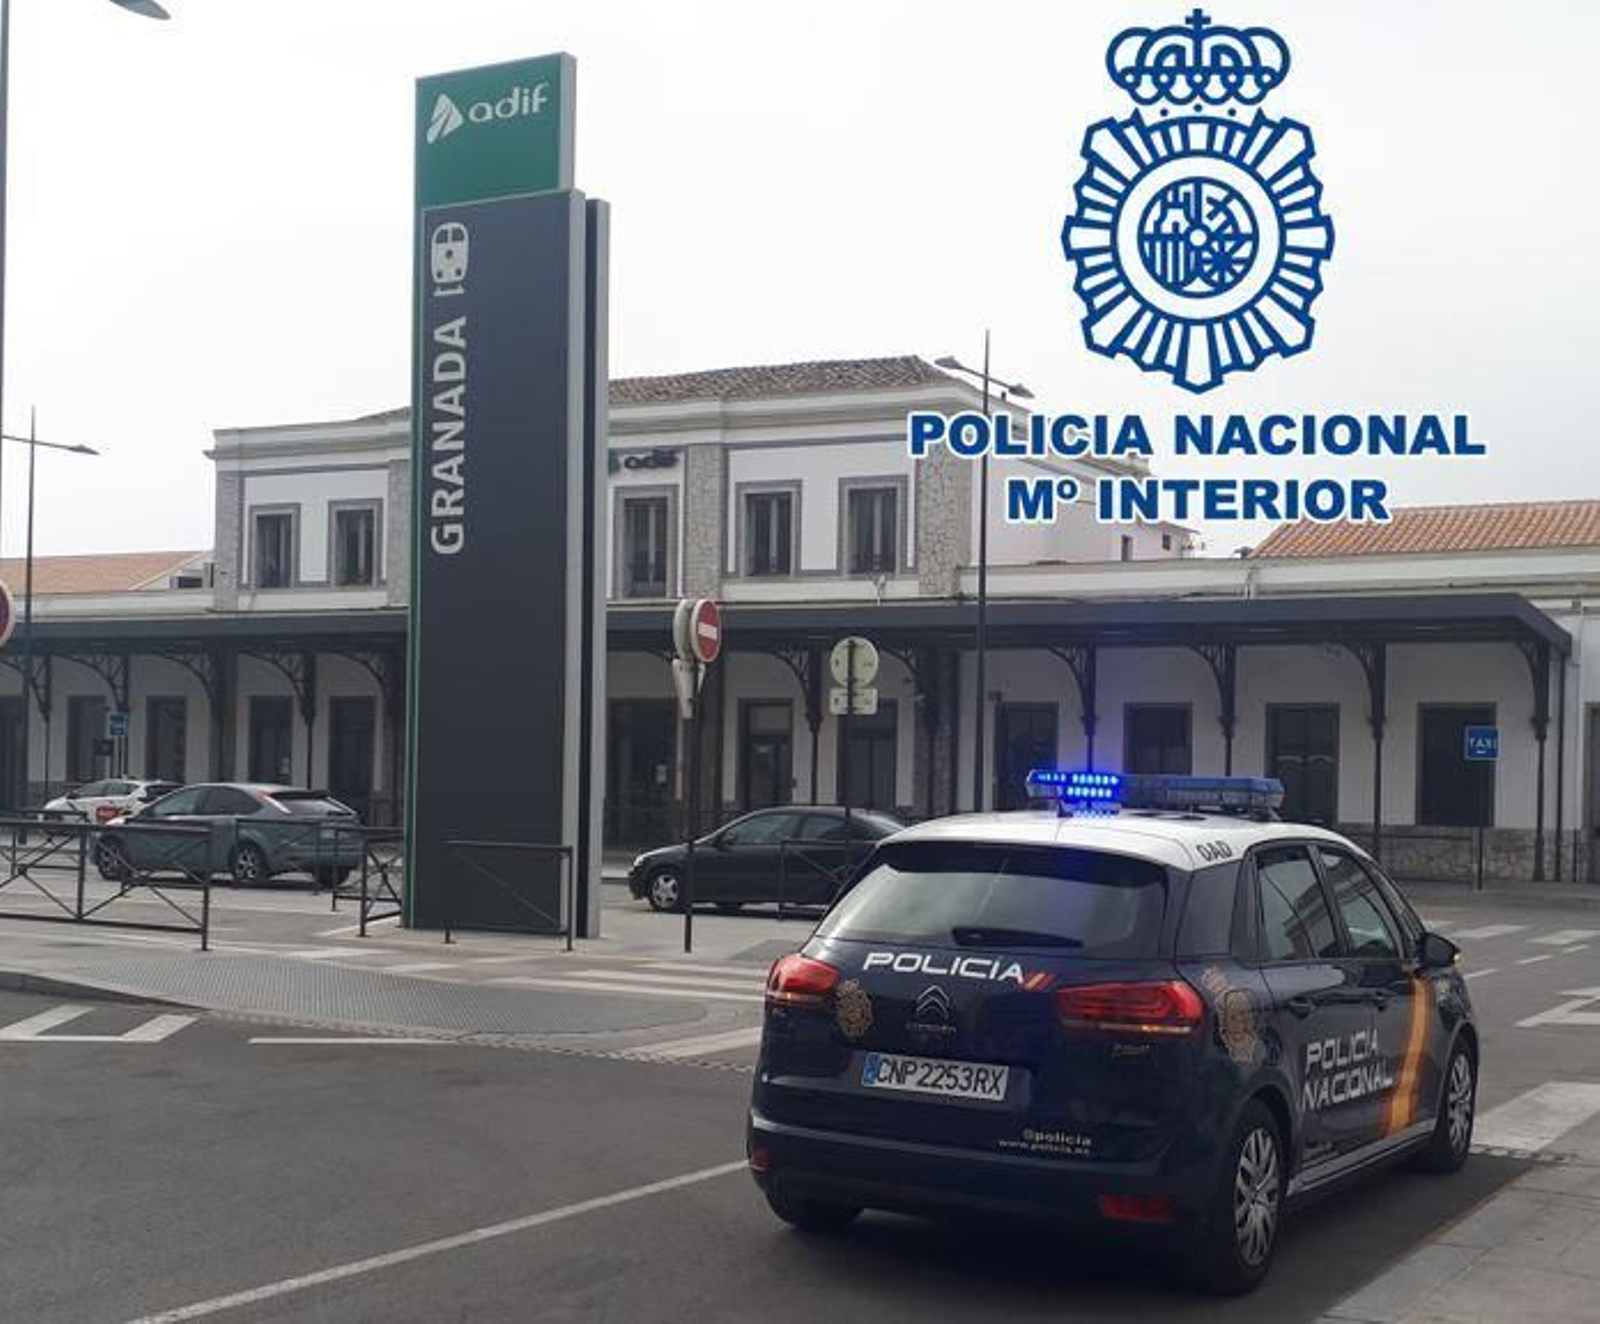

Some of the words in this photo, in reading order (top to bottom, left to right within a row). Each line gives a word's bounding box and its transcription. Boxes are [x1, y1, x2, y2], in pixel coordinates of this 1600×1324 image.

[468, 82, 549, 122] adif
[431, 316, 466, 554] GRANADA
[863, 952, 1025, 985] POLICIA
[1305, 1028, 1380, 1074] POLICIA
[1302, 1060, 1394, 1112] NACIONAL
